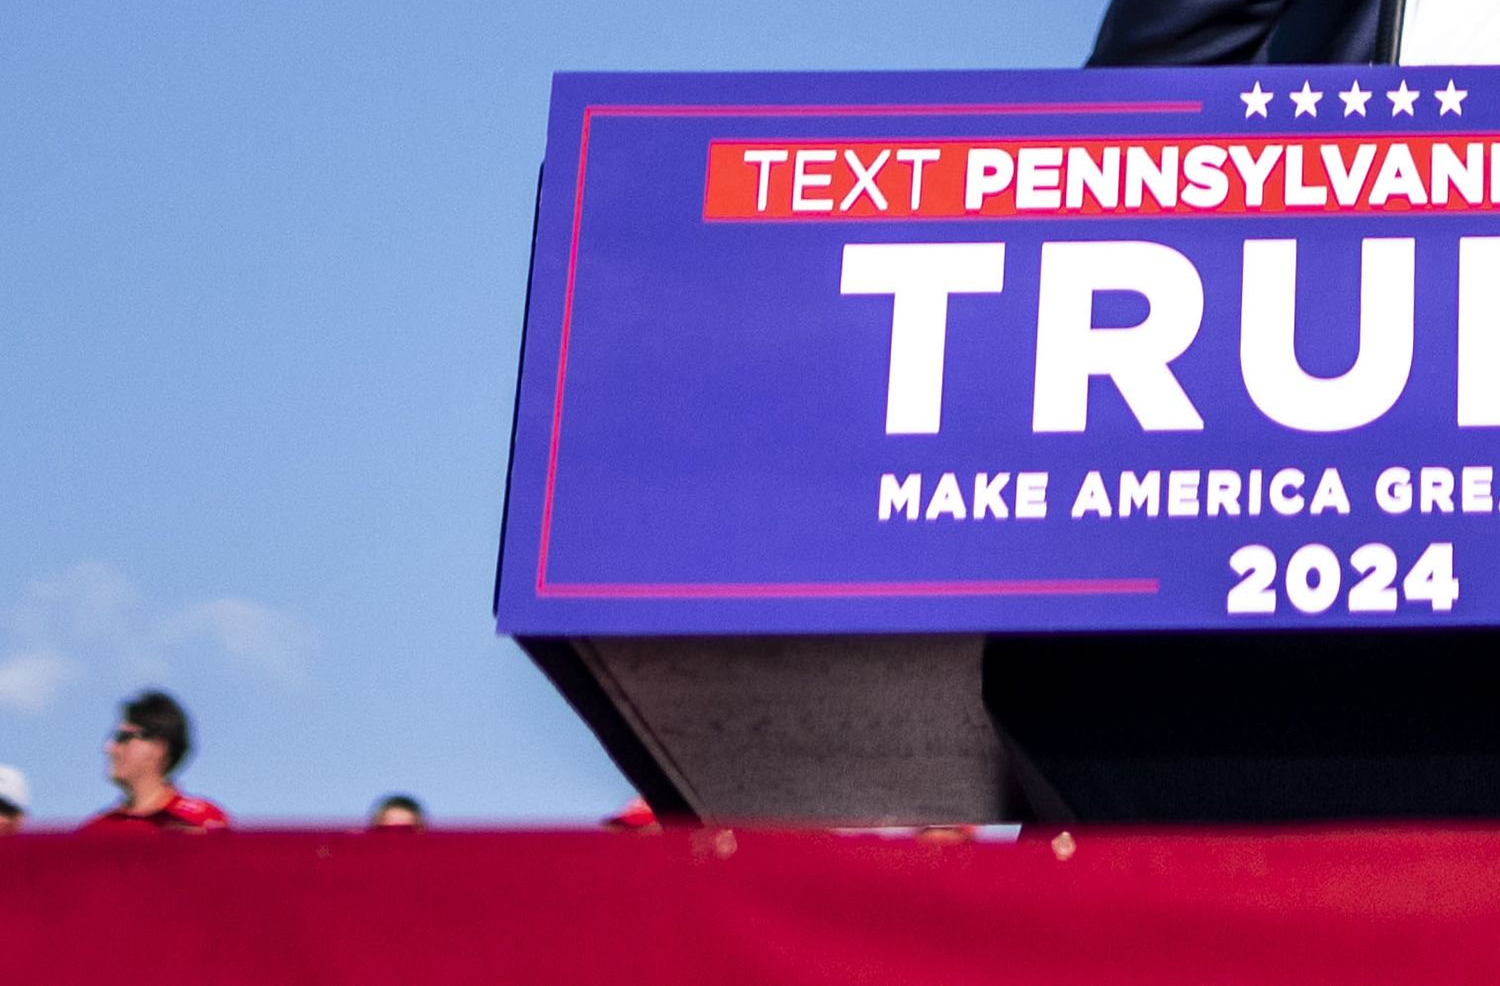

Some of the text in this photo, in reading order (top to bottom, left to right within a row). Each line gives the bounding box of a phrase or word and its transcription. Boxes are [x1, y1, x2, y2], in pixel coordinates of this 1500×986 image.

[743, 148, 941, 212] TEXT
[877, 471, 1050, 521] MAKE
[1070, 467, 1351, 519] AMERICA
[1226, 542, 1460, 615] 2024
